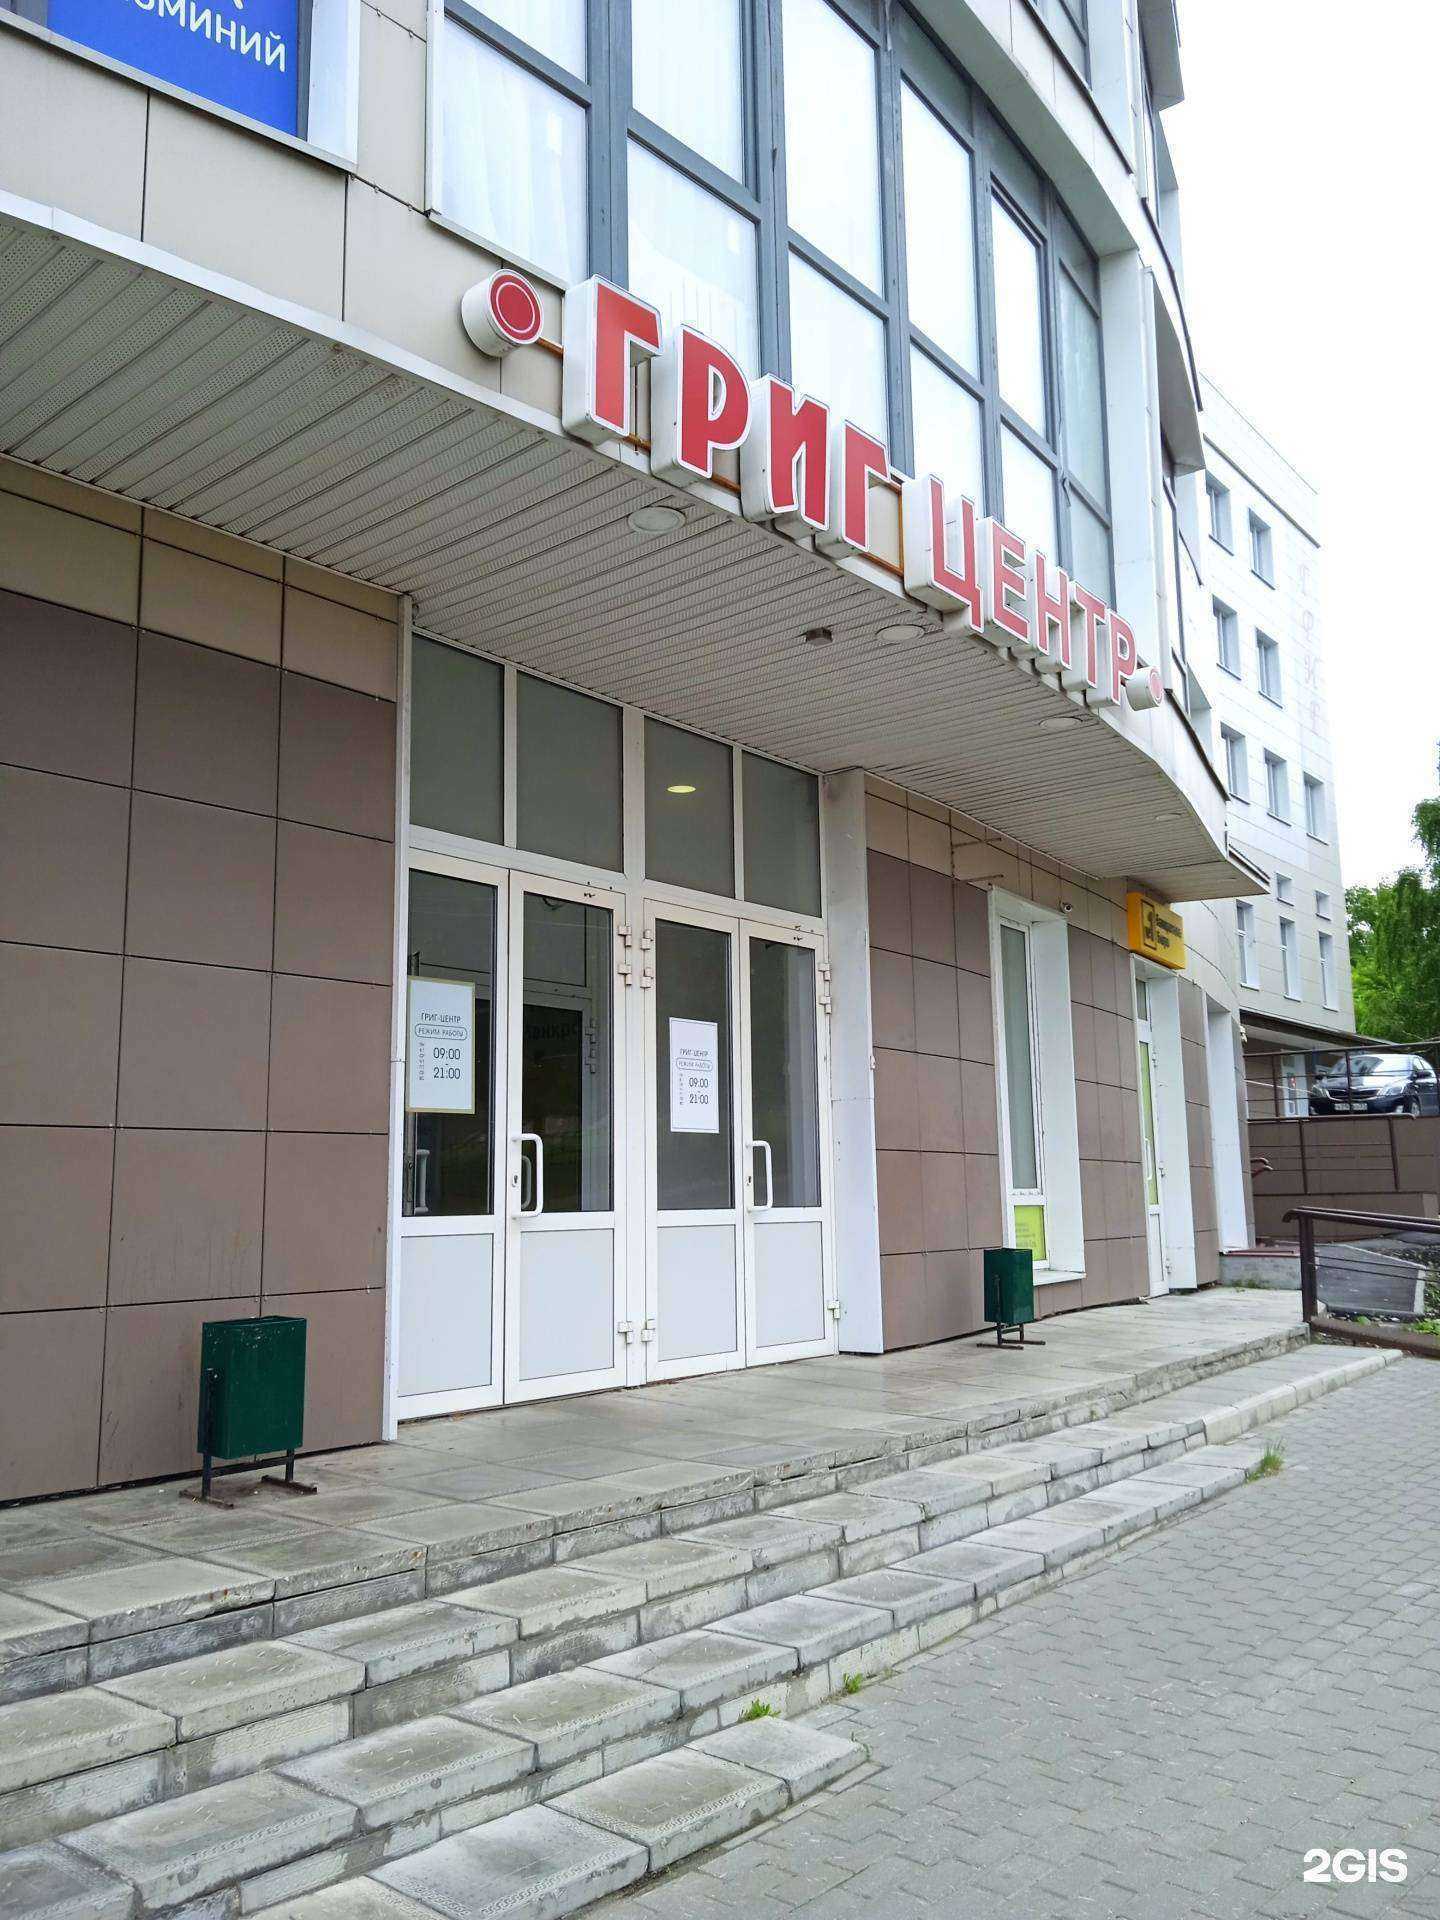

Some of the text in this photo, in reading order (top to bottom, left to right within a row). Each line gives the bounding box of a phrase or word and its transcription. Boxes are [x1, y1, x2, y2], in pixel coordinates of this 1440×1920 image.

[588, 274, 1136, 705] ГРИГ ЦЕНТР
[433, 1047, 461, 1060] 09:00
[433, 1066, 461, 1079] 21:00
